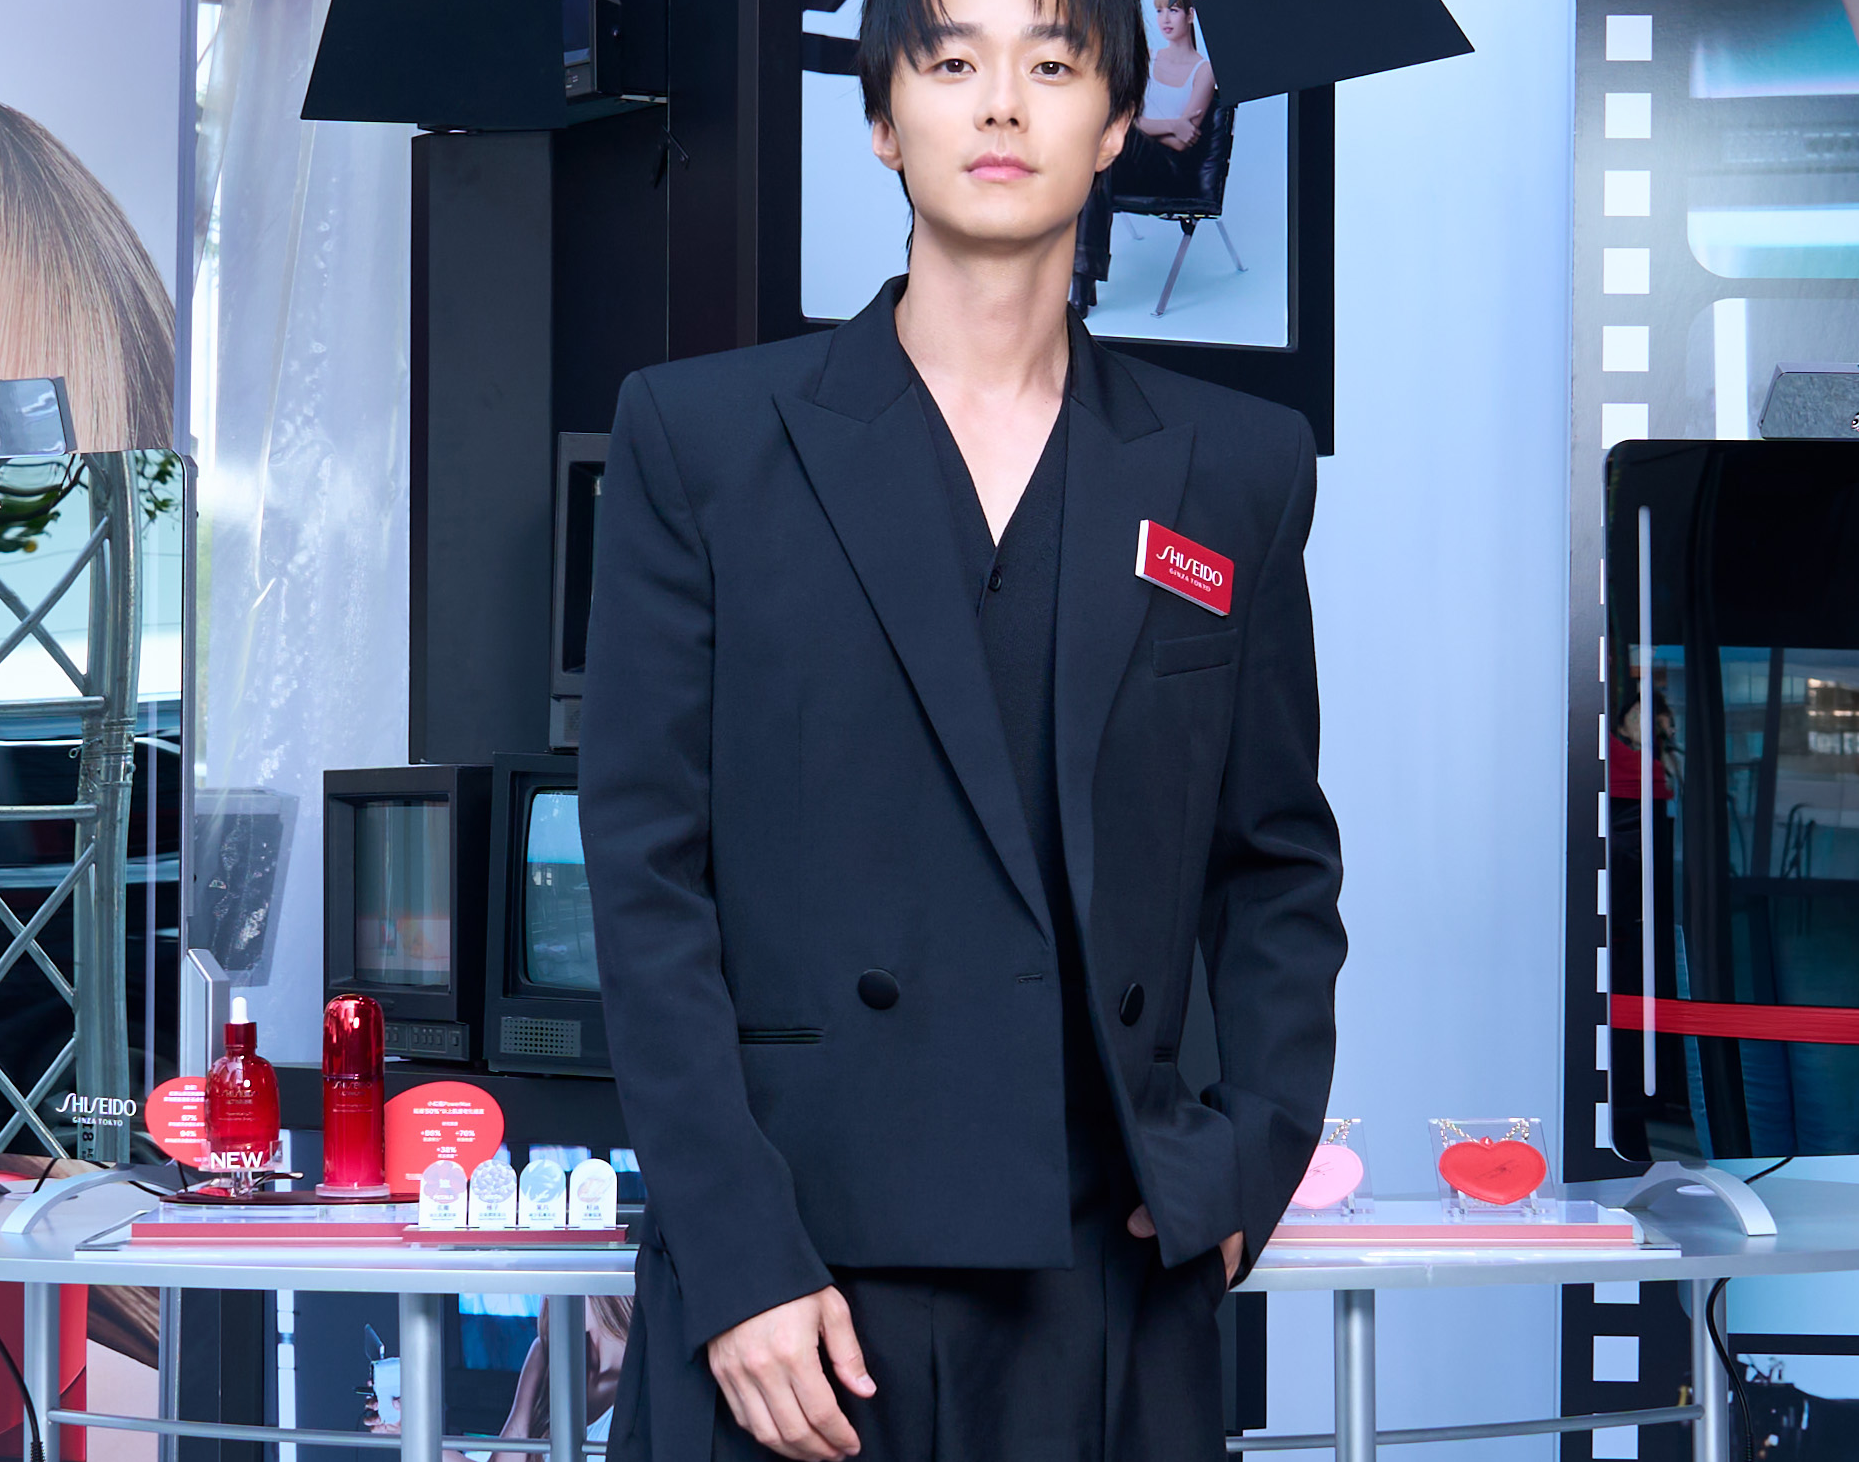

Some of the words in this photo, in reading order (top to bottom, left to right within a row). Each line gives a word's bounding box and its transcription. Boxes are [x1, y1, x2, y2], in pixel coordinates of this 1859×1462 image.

[1156, 546, 1223, 586] SHISEIDO
[55, 1093, 137, 1116] SHISEIDO
[72, 1116, 96, 1125] GINZA
[98, 1118, 123, 1127] TOKYO
[210, 1151, 263, 1169] NEW
